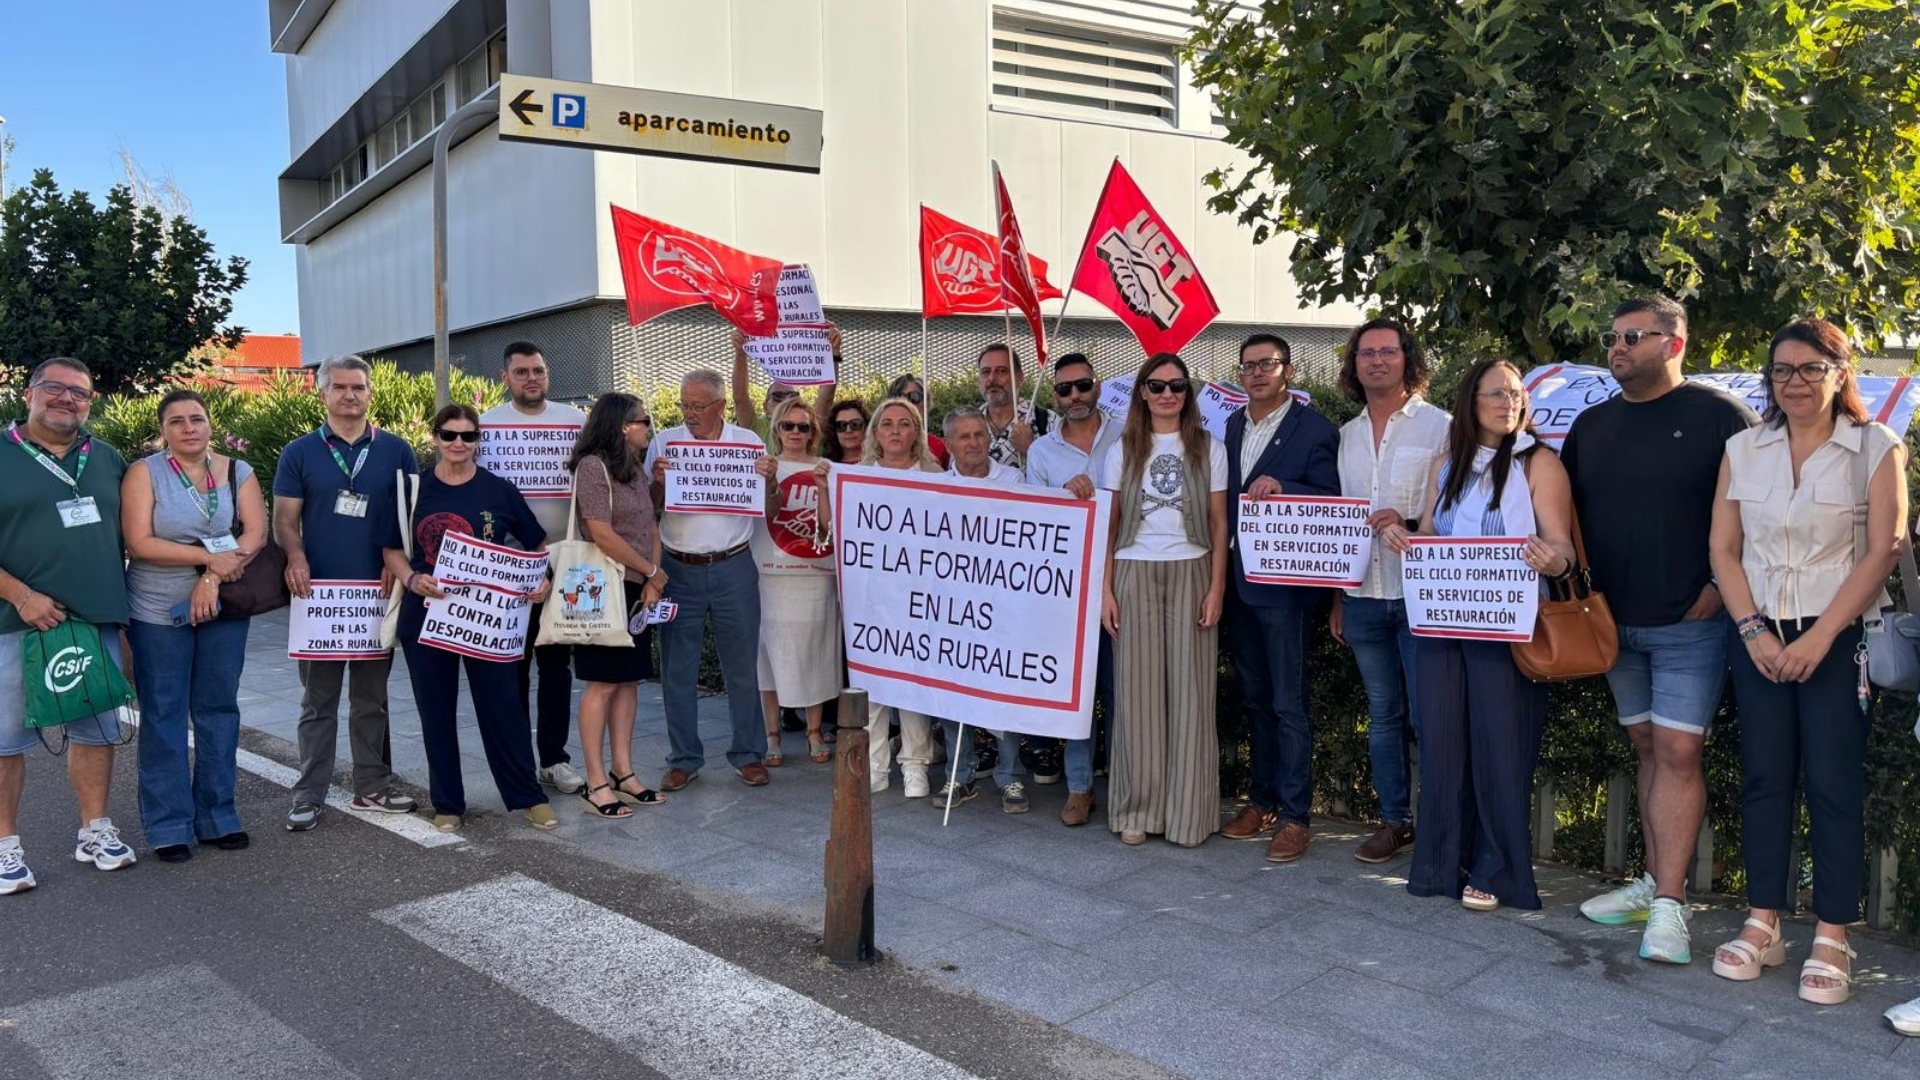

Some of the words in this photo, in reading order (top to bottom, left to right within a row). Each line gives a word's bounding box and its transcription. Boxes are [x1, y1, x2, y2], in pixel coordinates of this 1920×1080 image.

[558, 97, 579, 124] P
[618, 109, 791, 144] aparcamiento
[1124, 209, 1195, 290] UGT
[935, 243, 995, 284] UGT
[784, 302, 799, 310] LAS
[784, 312, 820, 322] RURALES
[744, 345, 759, 353] DEL
[762, 344, 785, 353] CICLO
[787, 343, 831, 352] FORMATIVO
[768, 356, 813, 366] SERVICIOS
[815, 356, 826, 364] DE
[1206, 388, 1221, 402] PO
[494, 431, 501, 440] A
[505, 431, 518, 440] LA
[496, 446, 525, 455] CICLO
[665, 447, 679, 457] NO
[682, 448, 689, 457] A
[693, 448, 706, 458] LA
[487, 462, 500, 470] EN
[504, 461, 559, 471] SERVICIOS
[562, 461, 570, 470] D
[671, 462, 682, 471] EL
[685, 463, 711, 472] CICLO
[677, 476, 689, 486] EN
[692, 476, 743, 488] SERVICIOS
[746, 479, 757, 489] DE
[682, 491, 752, 504] RESTAURACIÓN
[787, 484, 818, 510] UG
[1242, 503, 1260, 515] NO
[1264, 504, 1272, 516] A
[1277, 504, 1292, 516] LA
[1297, 502, 1369, 519] SUPRESIÓN
[857, 502, 893, 531] NO
[899, 507, 916, 535] A
[924, 509, 953, 539] LA
[961, 514, 1070, 554] MUERTE
[1240, 522, 1261, 533] DEL
[1265, 522, 1299, 535] CICLO
[1303, 524, 1370, 538] FORMATIVO
[443, 539, 458, 553] NO
[460, 545, 467, 555] A
[471, 548, 485, 560] LA
[1254, 540, 1269, 551] EN
[1273, 540, 1339, 554] SERVICIOS
[1343, 543, 1358, 555] DE
[1405, 547, 1423, 560] NO
[1427, 547, 1435, 560] A
[1440, 547, 1455, 560] LA
[1459, 543, 1525, 560] SUPRESIÓ
[438, 555, 455, 569] DEL
[458, 561, 488, 576] CICLO
[843, 539, 875, 569] DE
[882, 544, 911, 575] LA
[919, 549, 1074, 598] FORMACIÓN
[1260, 558, 1350, 573] RESTAURACIÓN
[1405, 568, 1425, 579] DEL
[1429, 568, 1462, 580] CICLO
[1465, 569, 1536, 582] FORMATIVO
[320, 588, 335, 600] LA
[475, 589, 492, 605] LA
[497, 595, 528, 610] LUCHA
[1419, 588, 1434, 600] EN
[1437, 589, 1502, 603] SERVICIOS
[1508, 590, 1524, 603] DE
[307, 606, 385, 618] PROFESIONAL
[447, 602, 502, 630] CONTRA
[506, 616, 518, 631] LA
[909, 591, 941, 622] EN
[947, 597, 994, 631] LAS
[1426, 607, 1516, 624] RESTAURACIÓN
[331, 624, 344, 634] EN
[348, 624, 367, 634] LAS
[425, 619, 524, 650] DESPOBLACIÓN
[308, 640, 344, 649] ZONAS
[348, 639, 383, 649] RURALE
[852, 623, 931, 662] ZONAS
[938, 637, 1058, 684] RURALES
